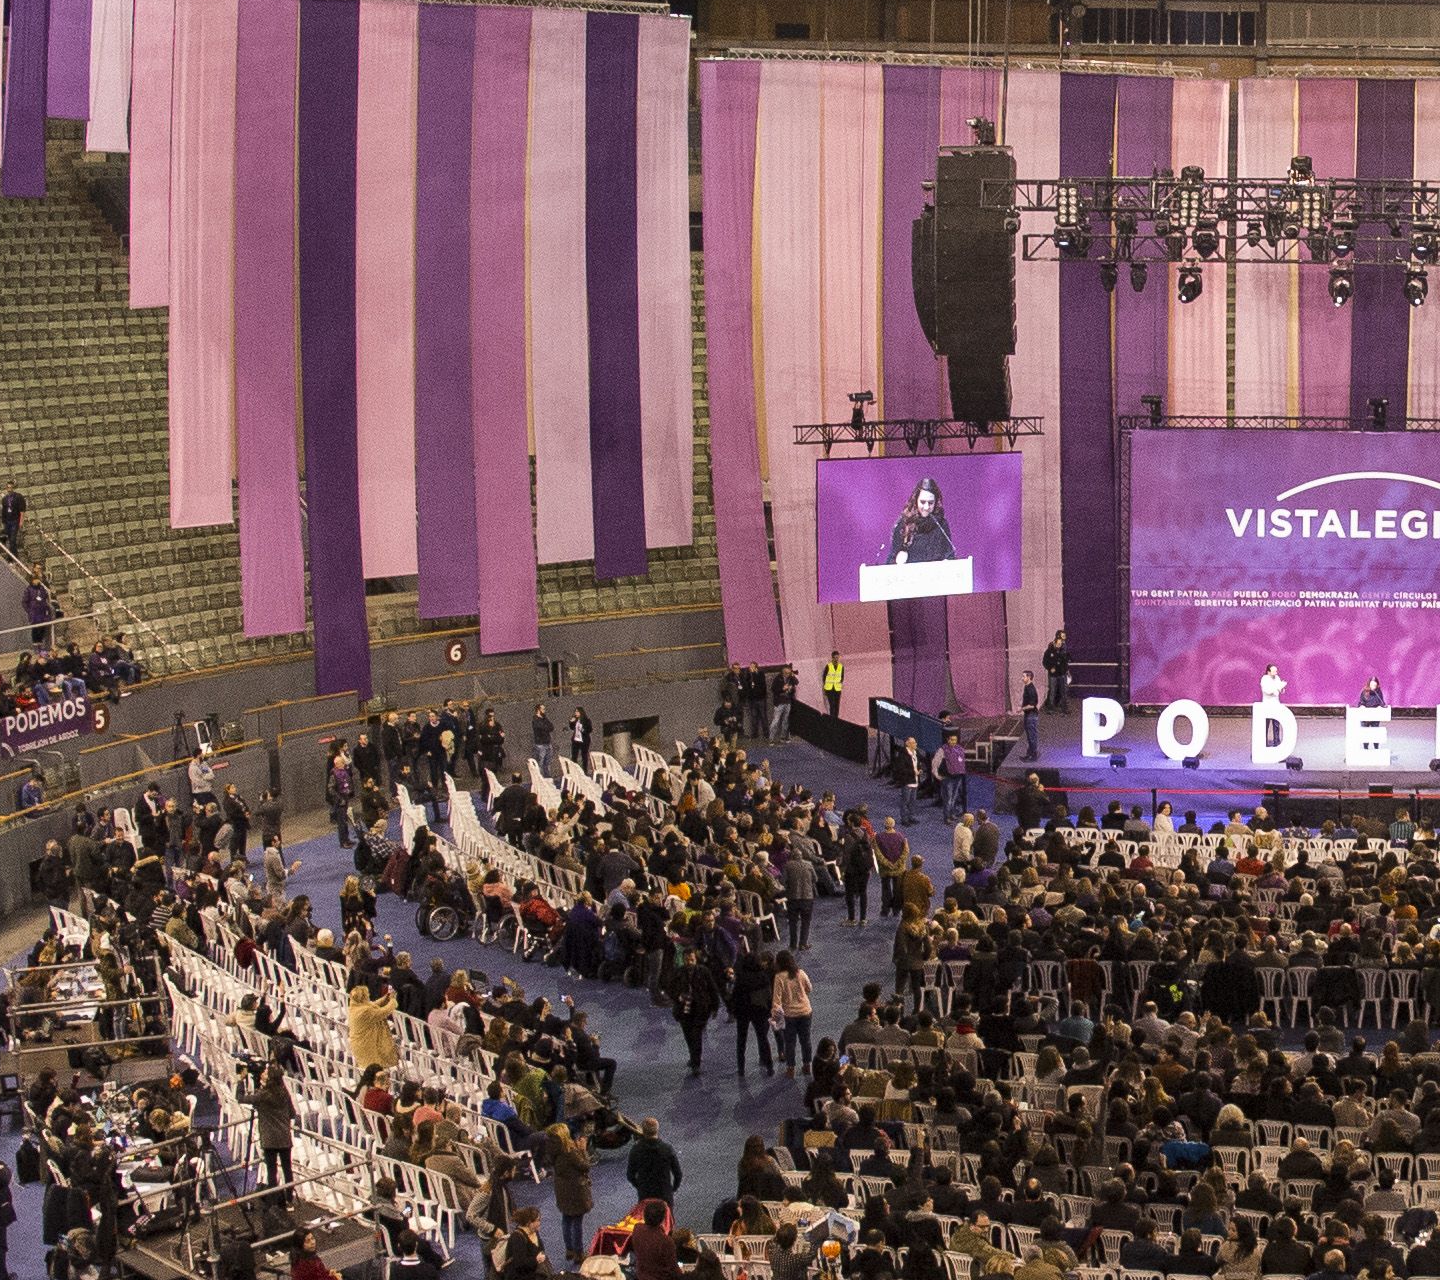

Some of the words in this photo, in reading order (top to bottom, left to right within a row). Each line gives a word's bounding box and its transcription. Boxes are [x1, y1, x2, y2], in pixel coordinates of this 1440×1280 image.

[1194, 599, 1238, 607] DEREITOS
[1241, 599, 1302, 607] PARTICIPACIÓ
[1338, 600, 1380, 608] DIGNITAT
[1421, 599, 1440, 608] PAÍS
[1299, 591, 1359, 599] DEMOKRAZIA
[1393, 591, 1437, 599] CÍRCULOS
[450, 644, 462, 662] 6
[5, 697, 86, 736] PODEMOS
[95, 709, 105, 729] 5
